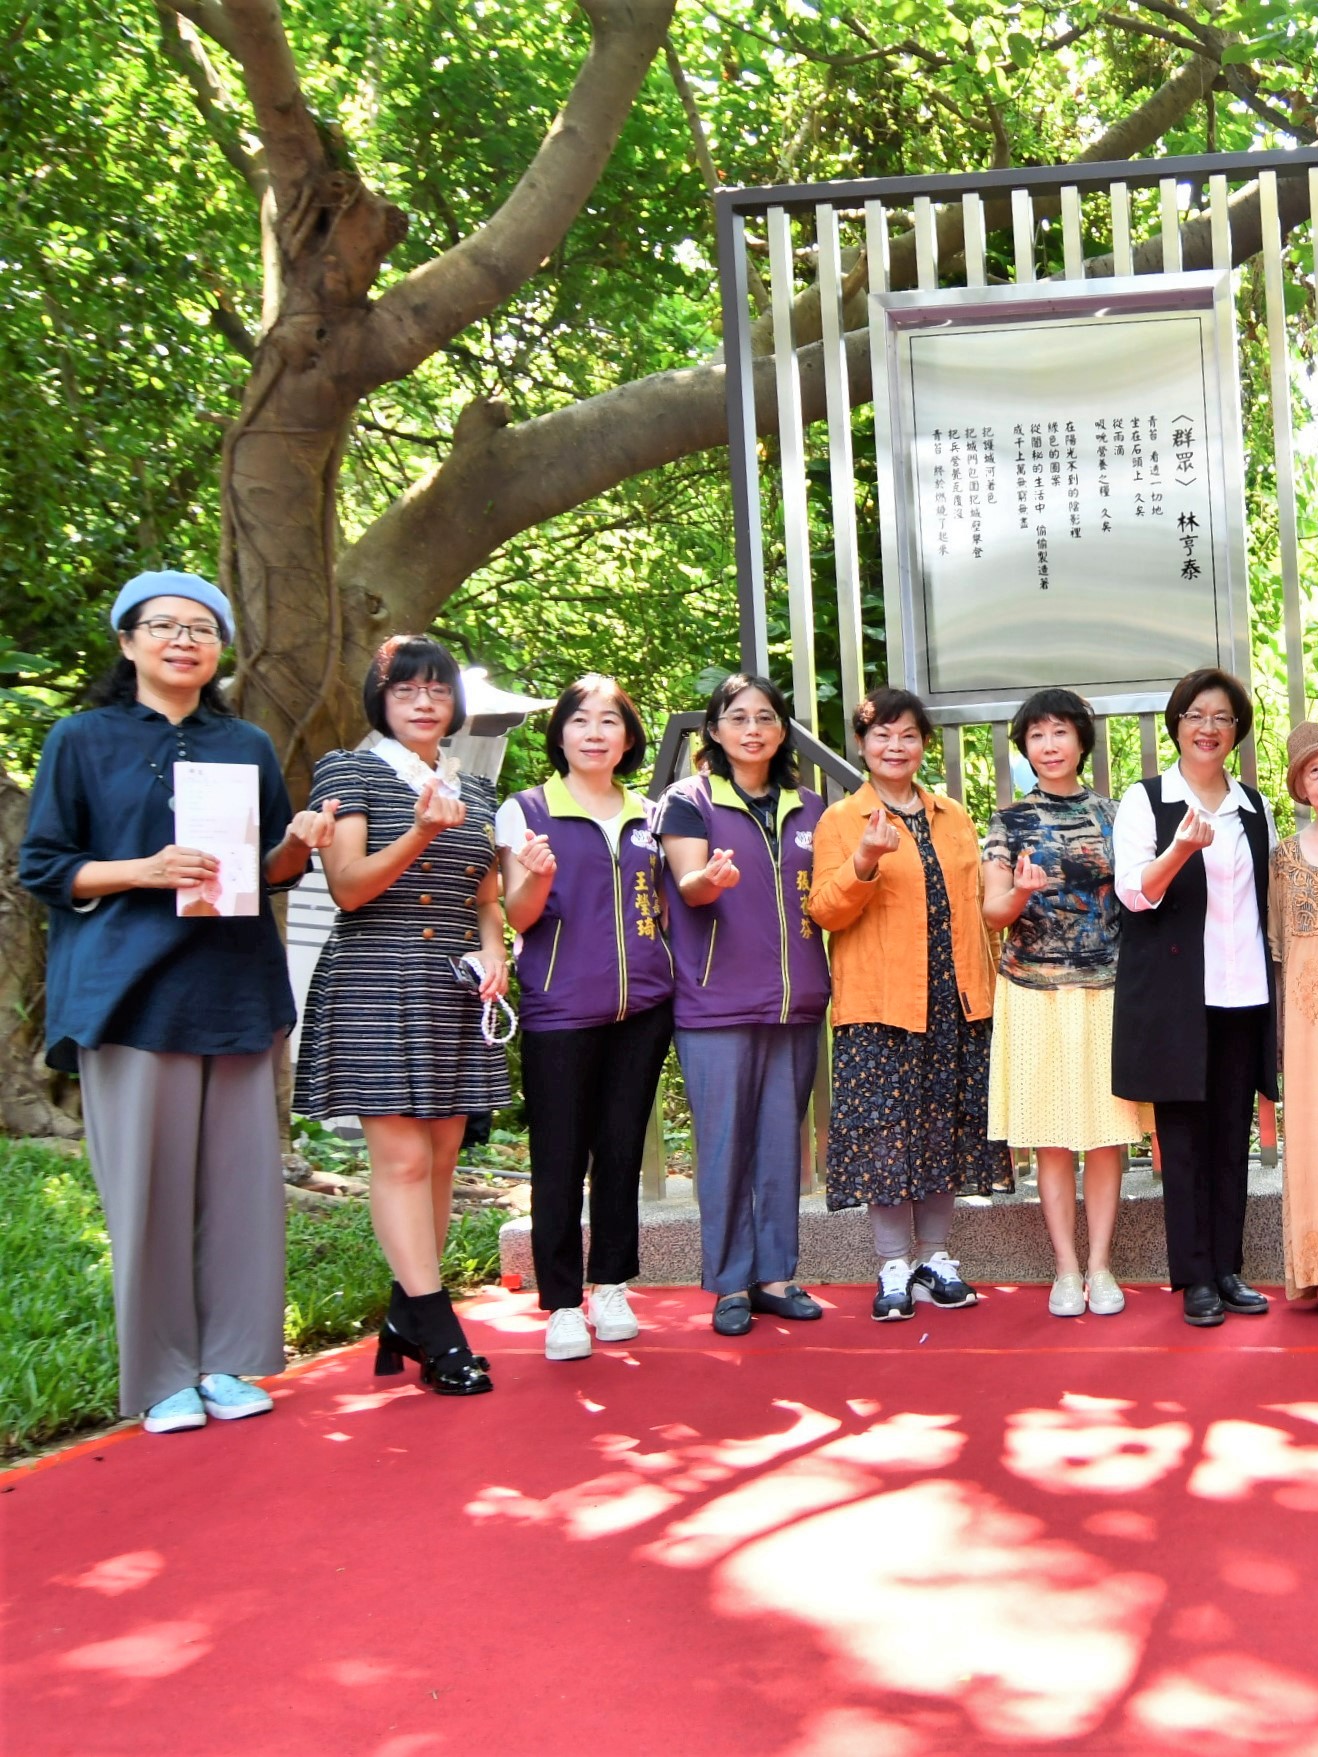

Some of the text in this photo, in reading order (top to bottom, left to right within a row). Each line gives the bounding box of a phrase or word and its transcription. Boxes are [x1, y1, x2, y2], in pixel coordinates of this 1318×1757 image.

[1064, 420, 1082, 539] 在陽光不到的陰影裡
[1112, 417, 1126, 457] 從雨滴
[1130, 416, 1146, 518] 坐在石頭上 久矣
[1147, 414, 1164, 516] 青苔 看透一切地
[1100, 507, 1112, 533] 久矣
[1176, 510, 1202, 581] 林亨泰
